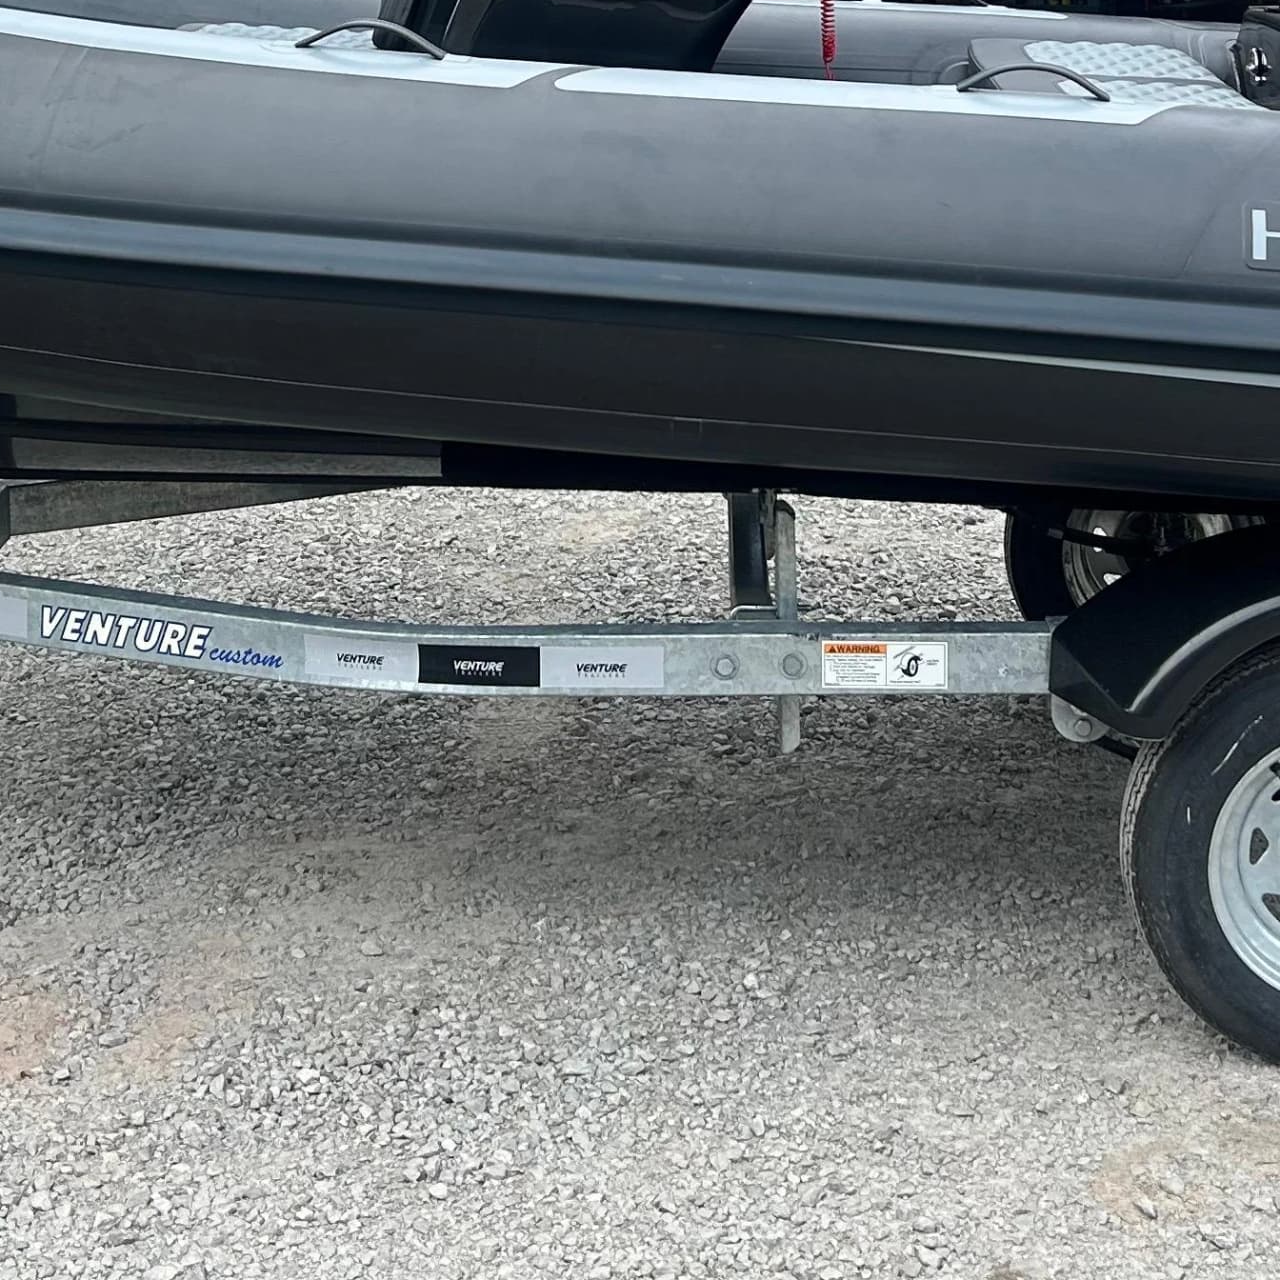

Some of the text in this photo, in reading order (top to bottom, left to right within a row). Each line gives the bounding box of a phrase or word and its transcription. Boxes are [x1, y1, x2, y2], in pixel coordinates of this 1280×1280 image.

[41, 604, 284, 669] VENTURE custom
[836, 645, 881, 654] WARNING
[336, 652, 385, 666] VENTURE
[453, 659, 505, 672] VENTURE
[576, 662, 628, 673] VENTURE
